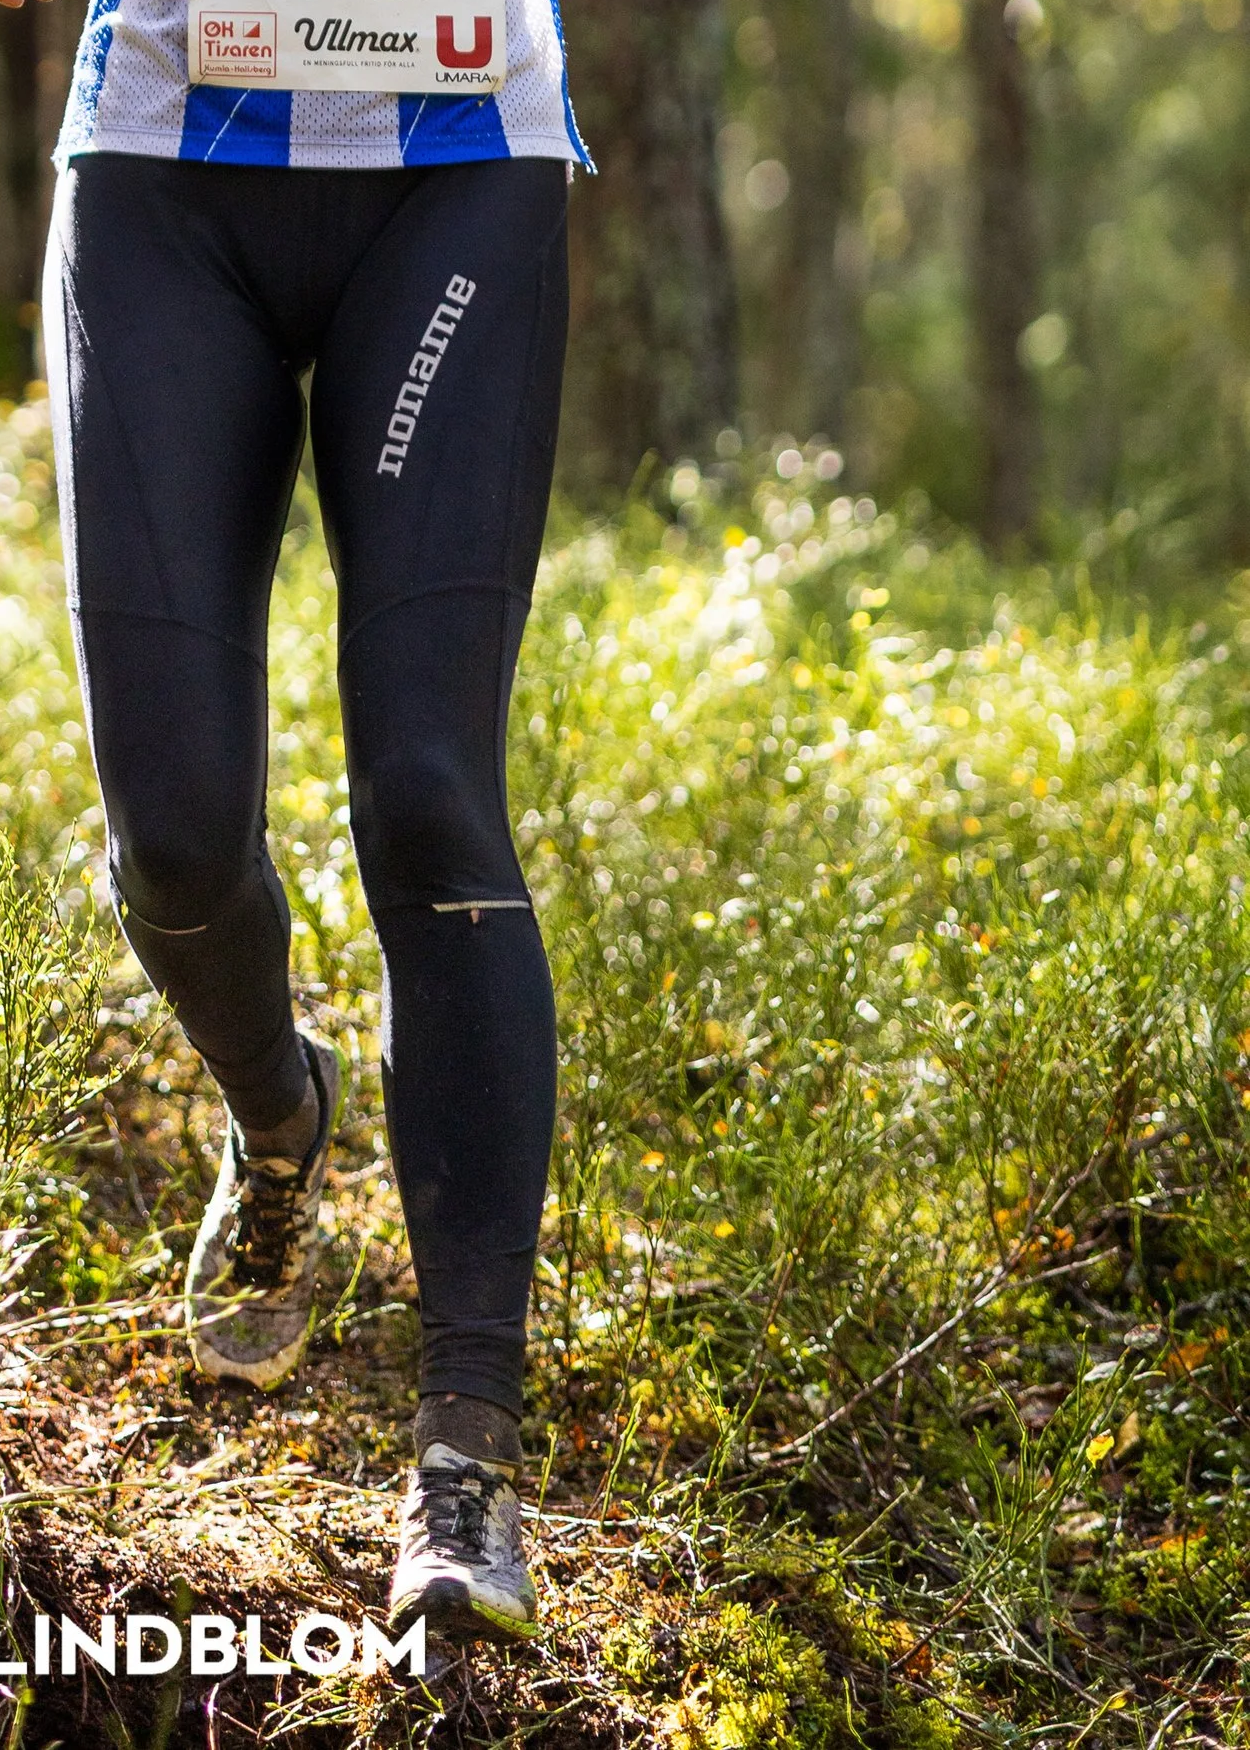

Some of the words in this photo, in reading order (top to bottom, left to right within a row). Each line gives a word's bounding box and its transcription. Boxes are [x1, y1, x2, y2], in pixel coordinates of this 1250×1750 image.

[294, 17, 418, 53] Ullmax
[204, 40, 272, 58] Tisaren
[314, 59, 359, 67] MENINGSFULL
[435, 71, 492, 83] UMARA
[377, 273, 477, 478] noname
